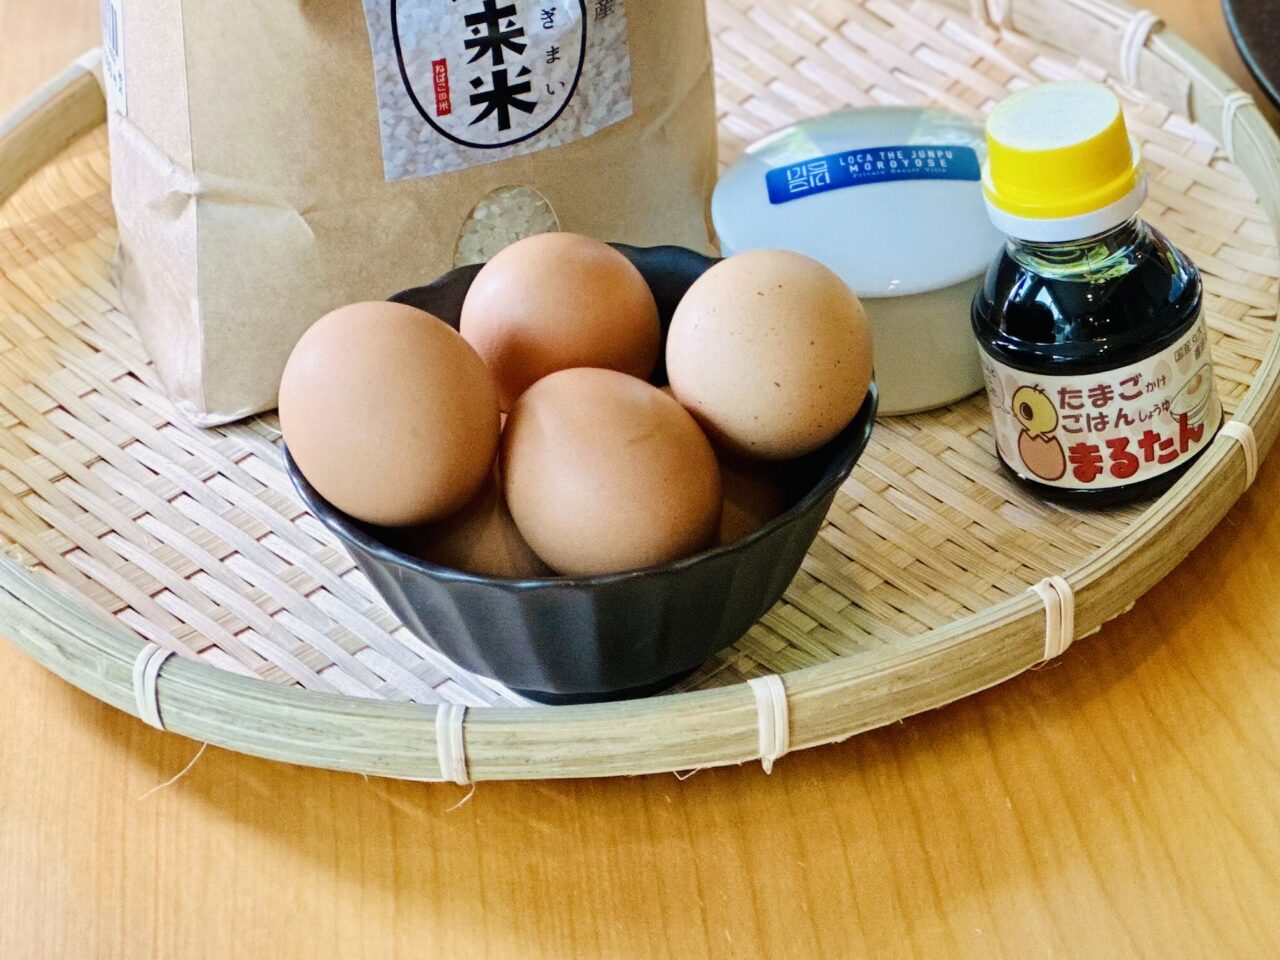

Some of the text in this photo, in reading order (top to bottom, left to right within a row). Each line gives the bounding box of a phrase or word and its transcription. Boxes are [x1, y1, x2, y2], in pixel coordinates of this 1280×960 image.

[838, 149, 954, 166] LOCA THE JUNPU
[848, 159, 948, 173] MOROYOSE
[1057, 373, 1168, 411] たまごかけ
[1061, 400, 1172, 435] ごはんしょうゆ
[1068, 413, 1205, 484] まるたん
